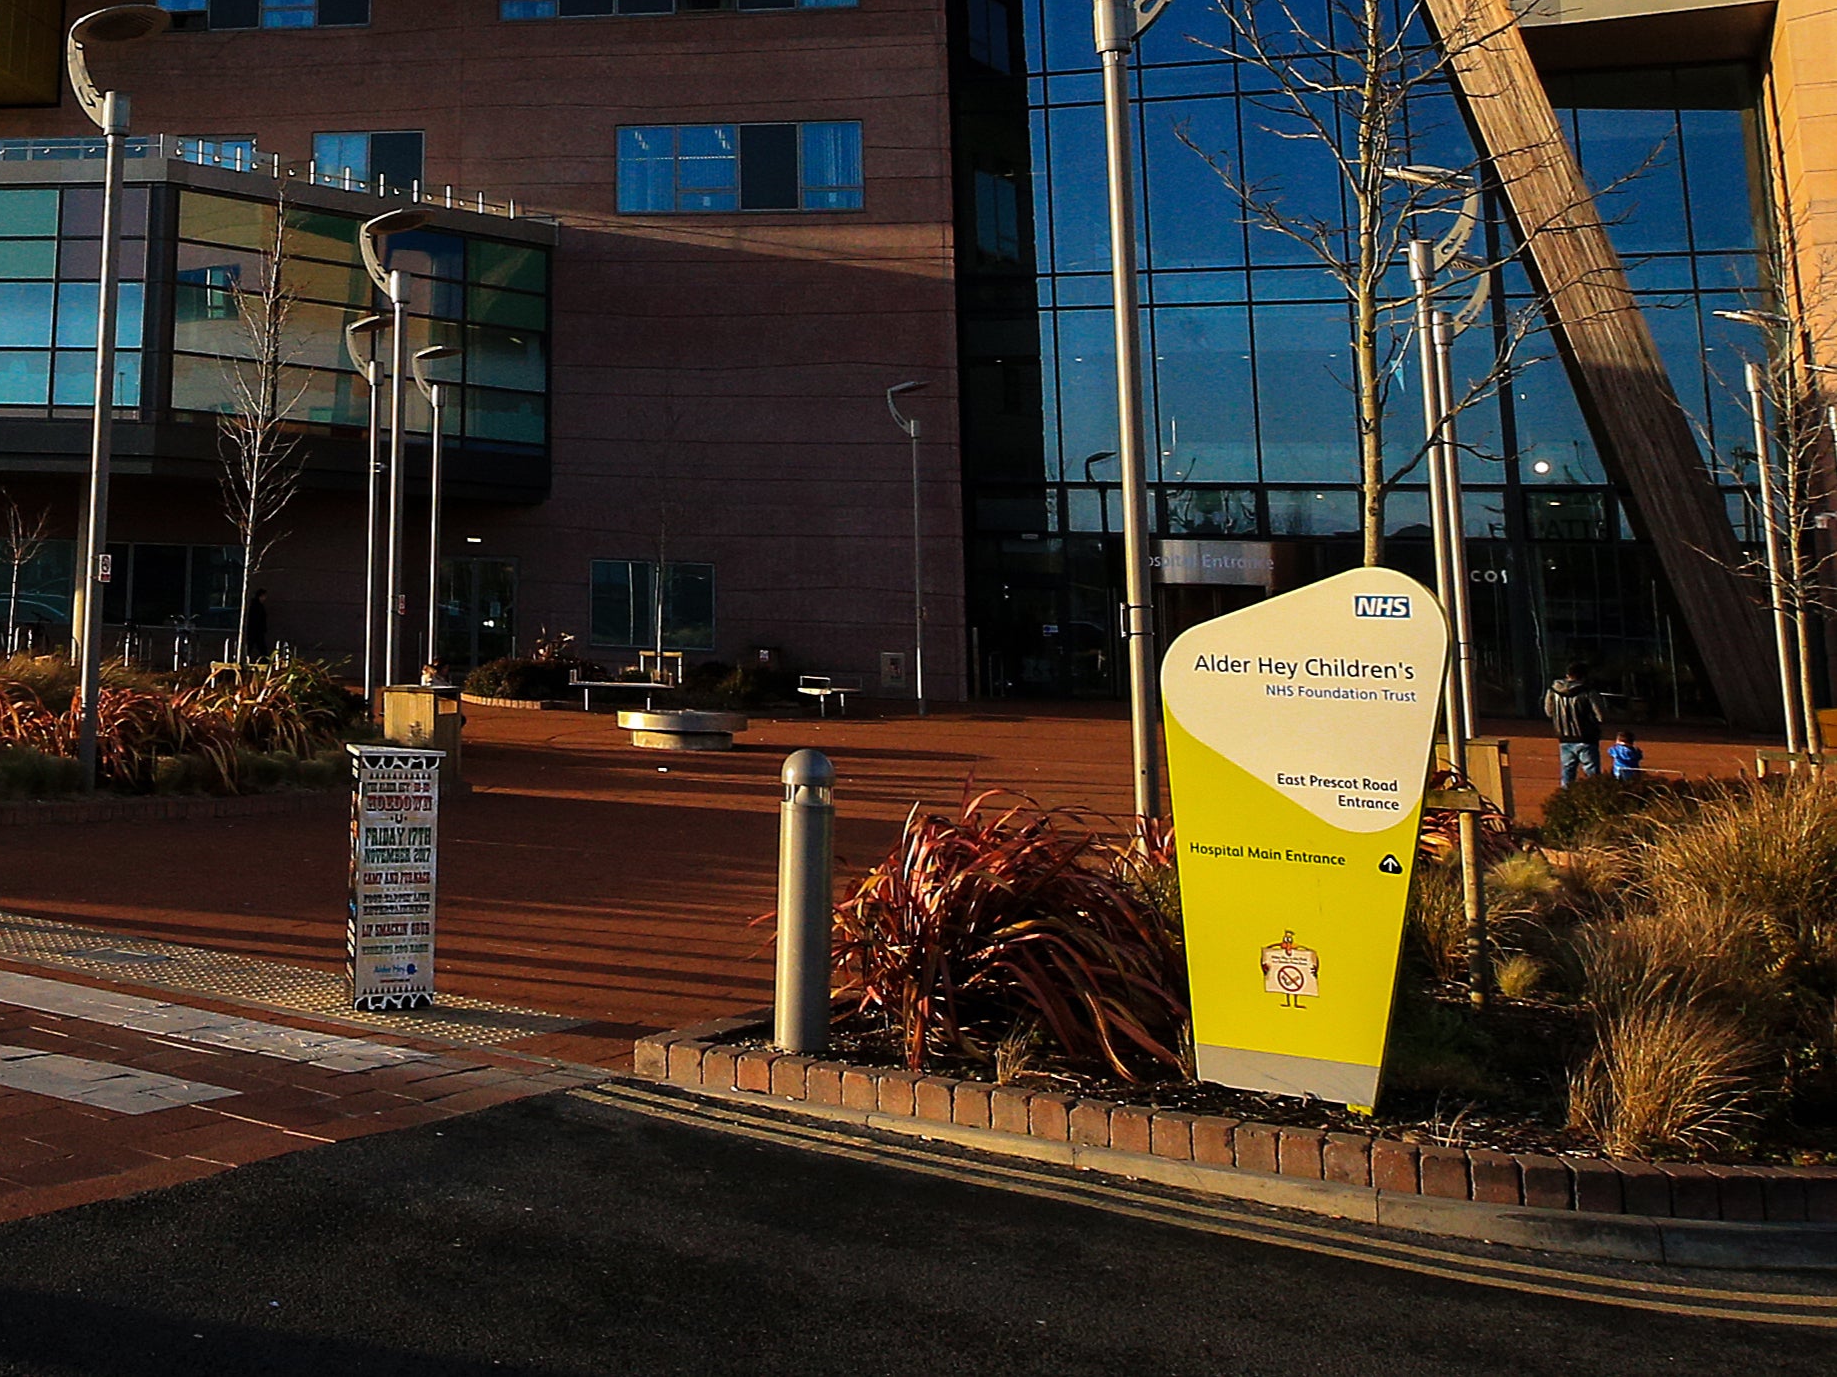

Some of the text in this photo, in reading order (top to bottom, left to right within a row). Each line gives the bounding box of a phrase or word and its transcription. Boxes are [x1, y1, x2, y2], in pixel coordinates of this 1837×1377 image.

[1357, 597, 1408, 616] NHS
[1194, 654, 1415, 680] Alder Hey Children's
[1266, 684, 1417, 703] NHS Foundation Trust
[1277, 773, 1399, 792] East Prescot Road
[1338, 794, 1400, 811] Entrance
[365, 827, 431, 846] FRIDAY 17TH
[364, 848, 411, 864] NOVEMBER
[1190, 842, 1346, 866] Hospital Main Entrance
